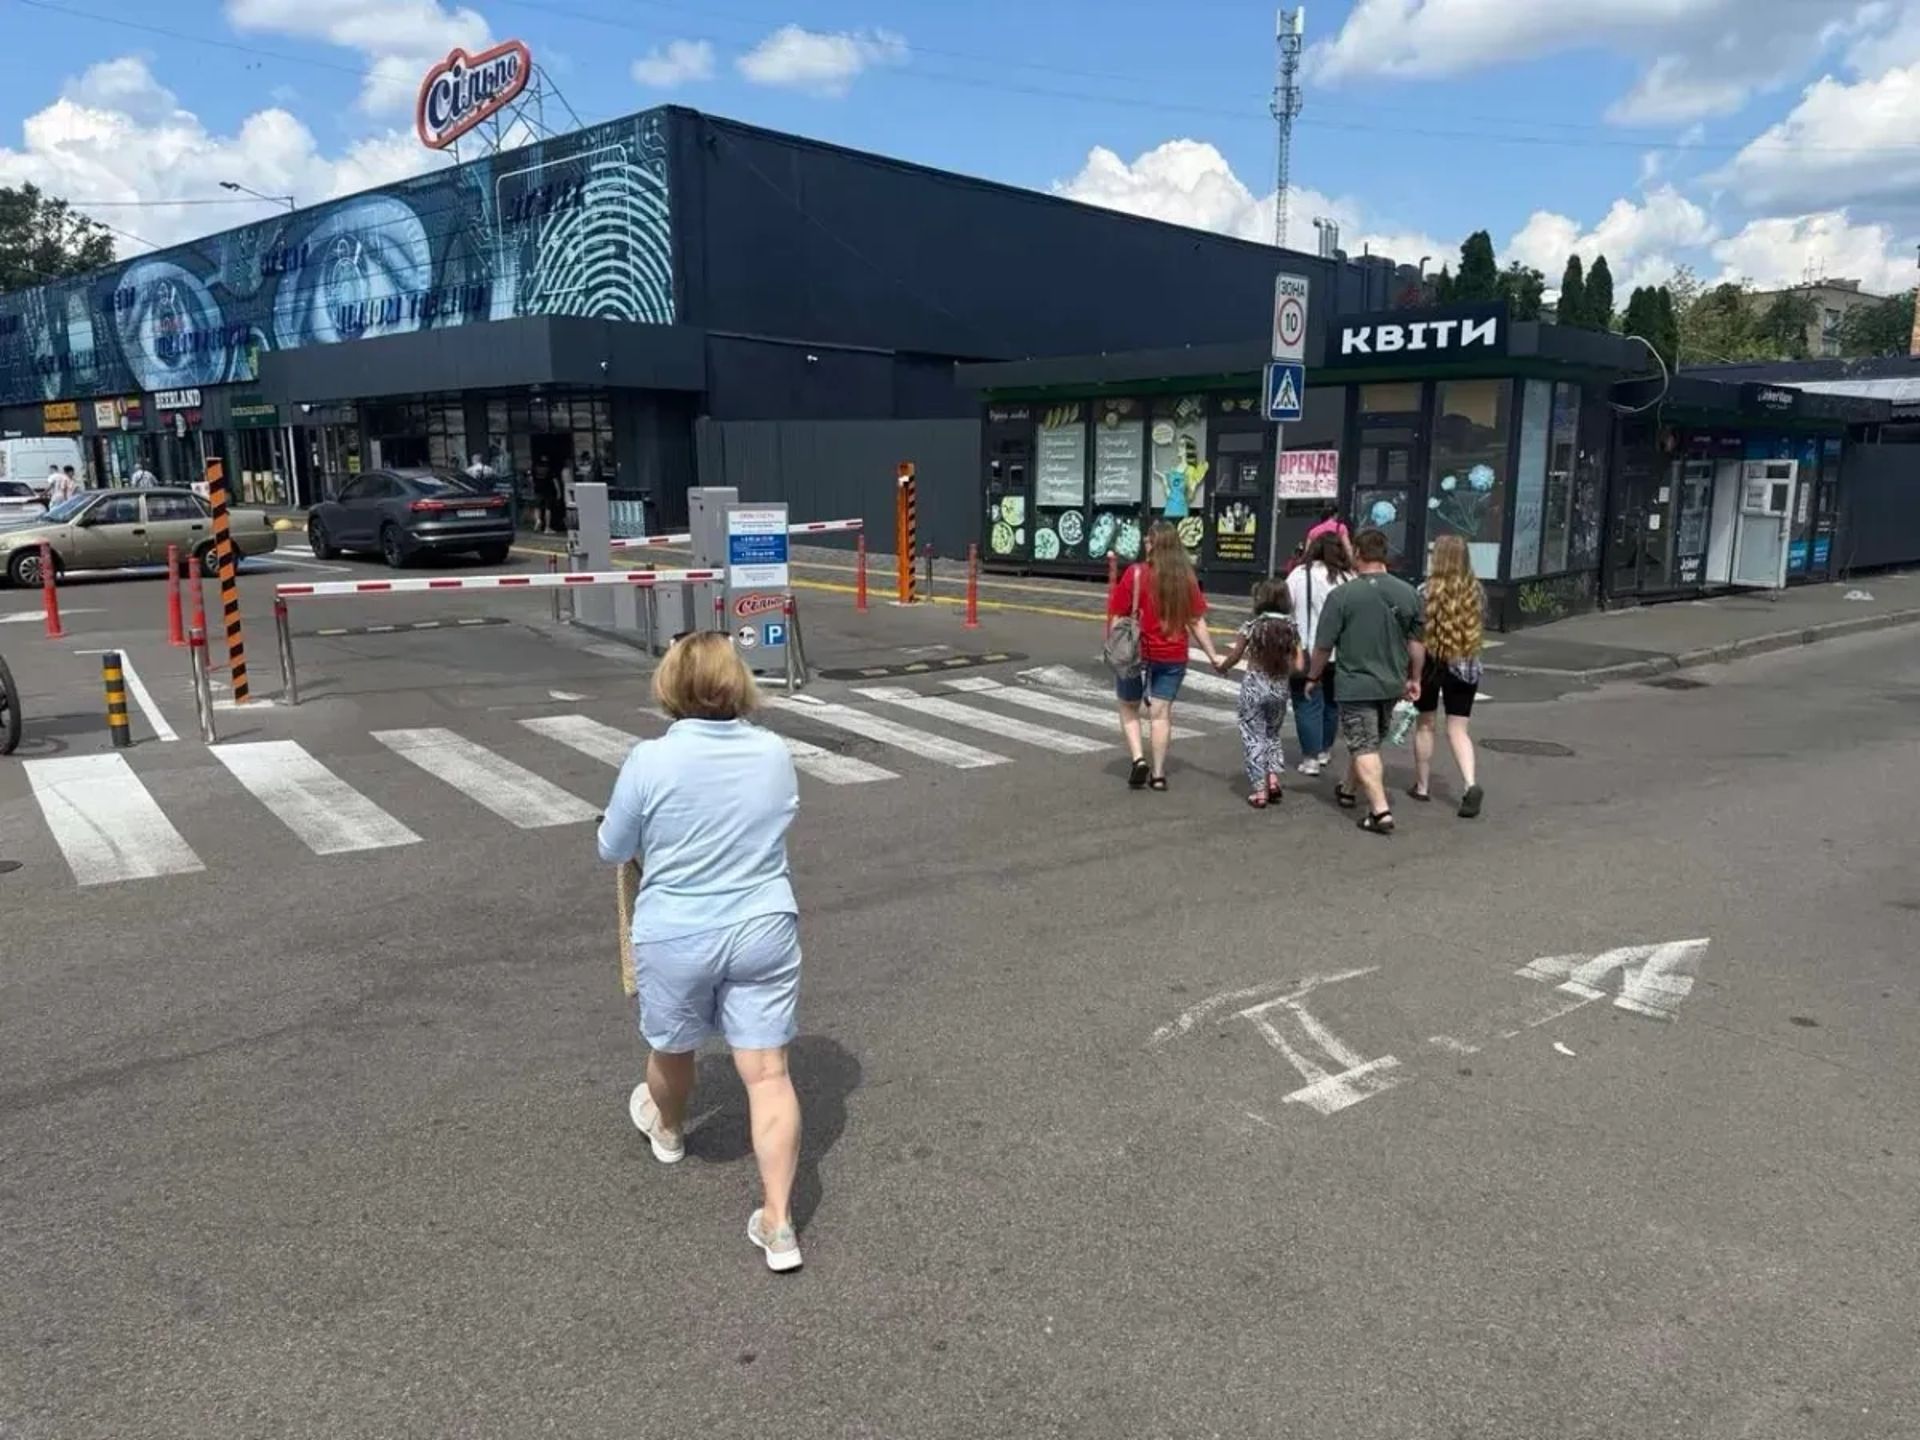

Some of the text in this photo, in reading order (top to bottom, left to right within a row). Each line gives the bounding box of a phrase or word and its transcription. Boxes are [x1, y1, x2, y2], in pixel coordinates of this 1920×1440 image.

[428, 55, 518, 129] Сільпо
[1280, 280, 1305, 297] ЗОНА
[1285, 312, 1298, 332] 10
[1341, 317, 1498, 355] КВІТИ
[154, 389, 201, 410] BEERLAND
[768, 625, 782, 644] P
